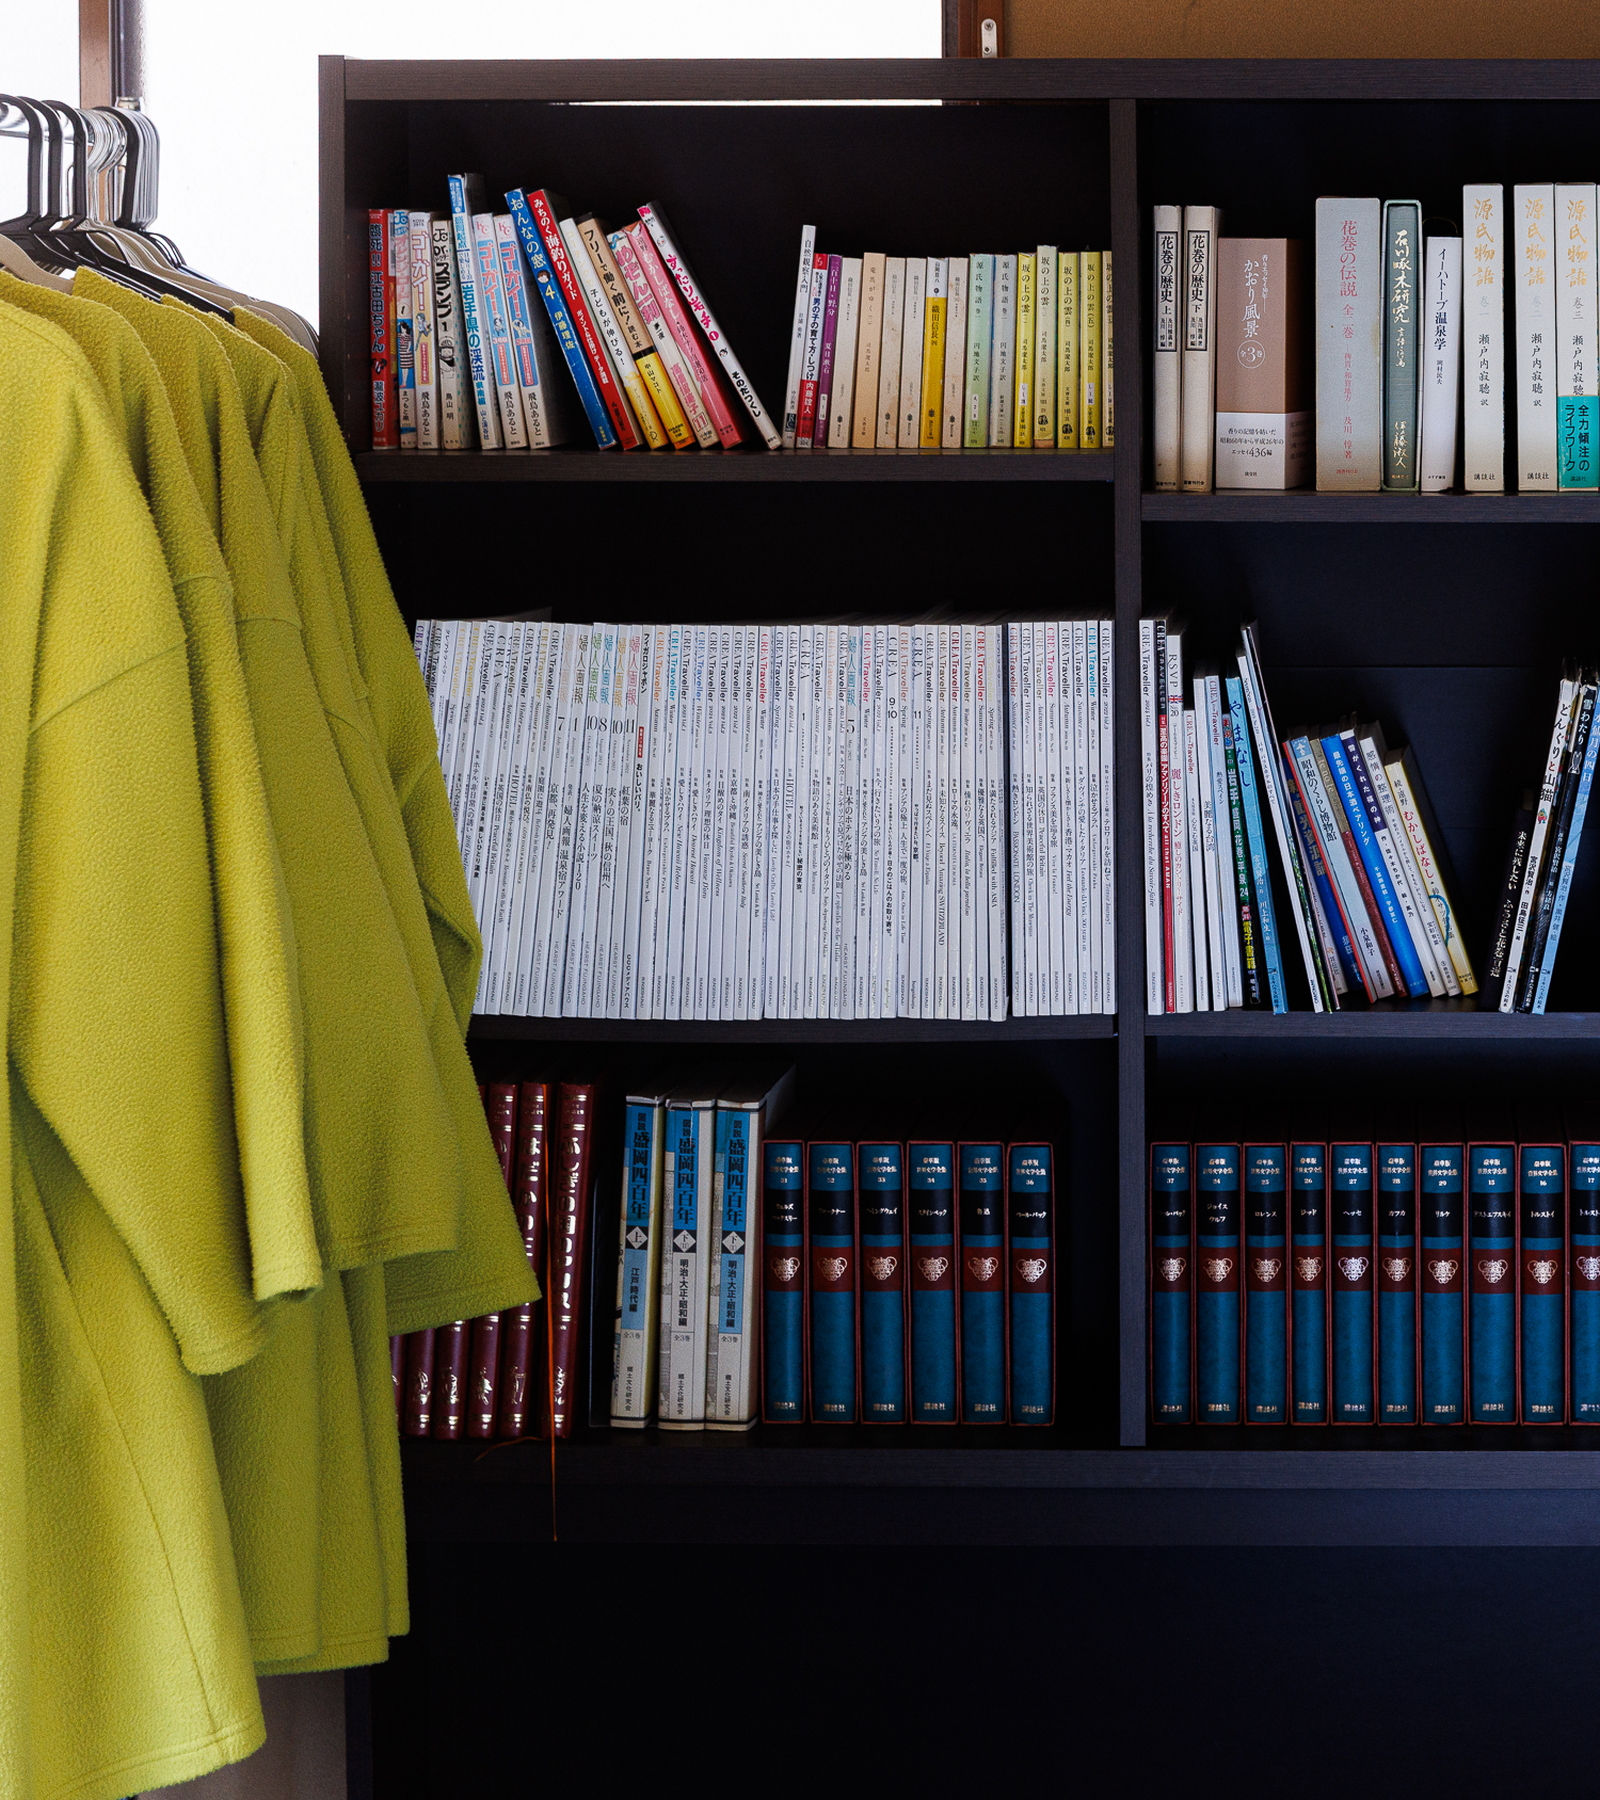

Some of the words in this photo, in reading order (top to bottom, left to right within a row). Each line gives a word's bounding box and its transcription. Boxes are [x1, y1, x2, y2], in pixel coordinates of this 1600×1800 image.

[511, 198, 546, 269] おんなの窓
[1340, 220, 1358, 297] 花巻の伝説
[1472, 198, 1495, 286] 源氏物語
[1523, 198, 1547, 286] 源氏物語
[1566, 199, 1589, 287] 源氏物語
[1242, 259, 1261, 338] かおり風景
[1434, 248, 1449, 350] イーハトーブ温泉学
[1565, 405, 1576, 472] ライフワーク
[1579, 404, 1590, 472] 全力傾注の
[1229, 701, 1250, 787] やまなし
[1540, 703, 1573, 803] どんぐりと山猫
[1577, 698, 1595, 746] 雪わたり
